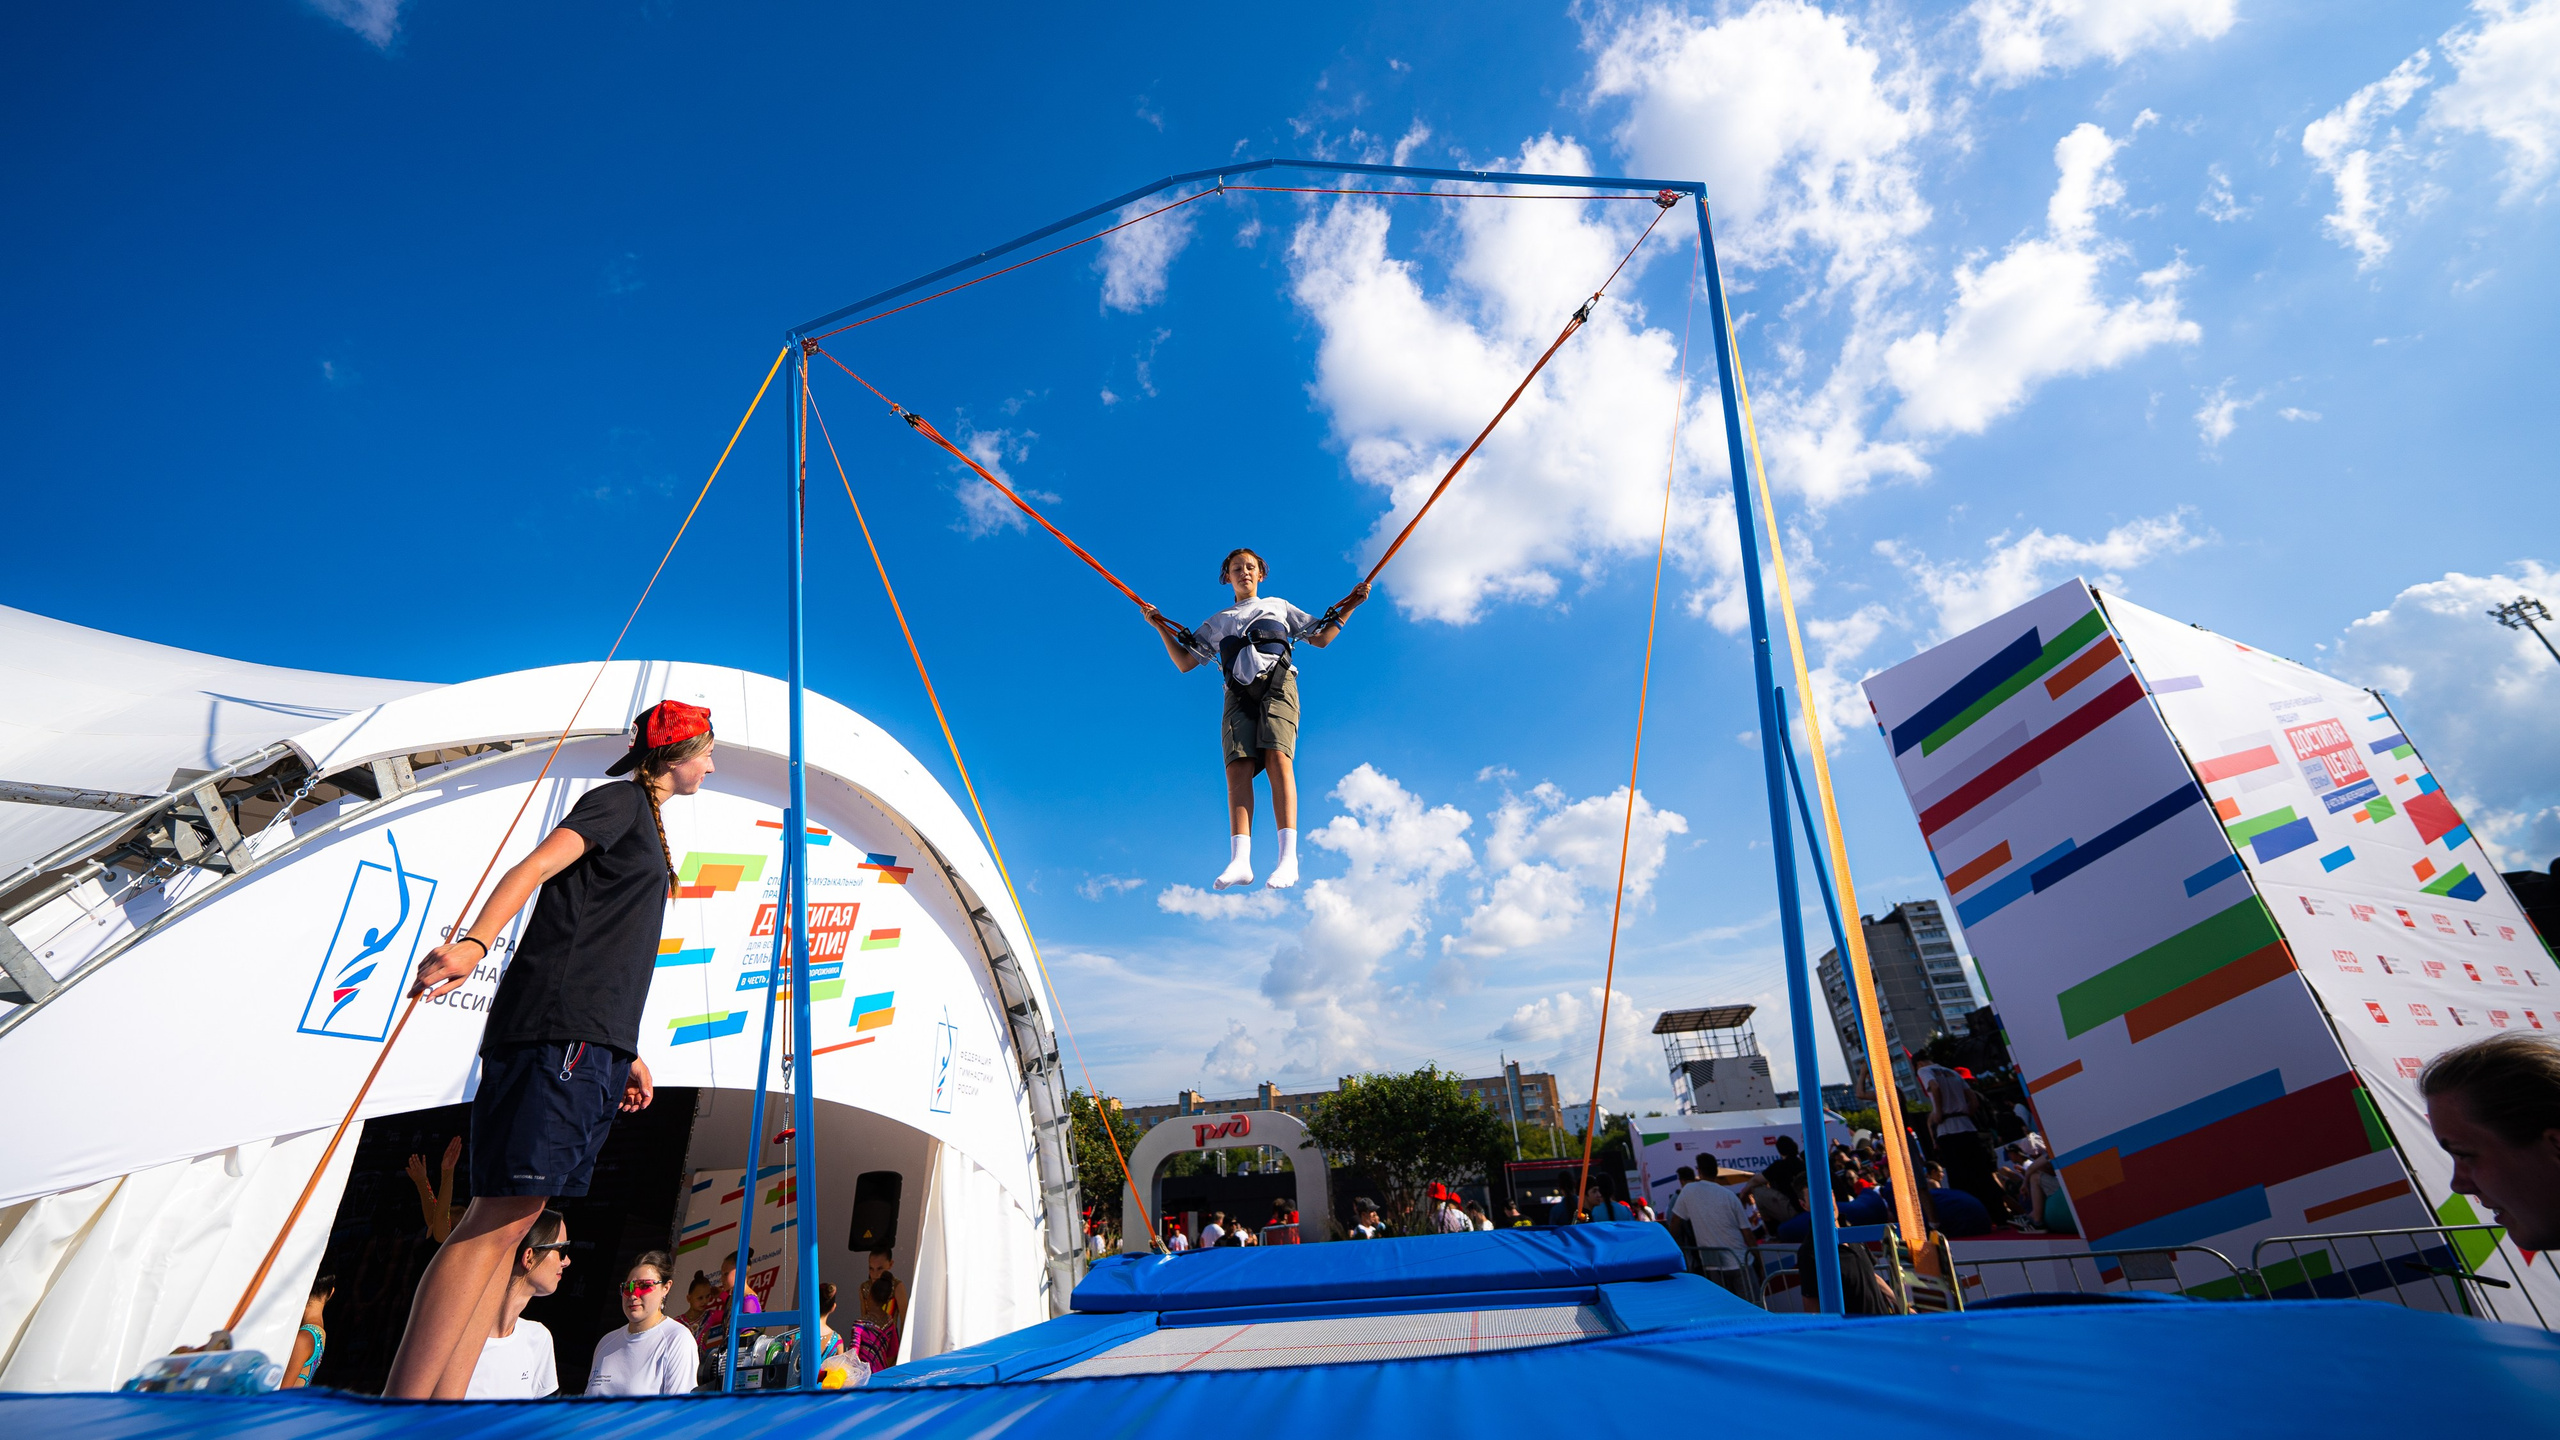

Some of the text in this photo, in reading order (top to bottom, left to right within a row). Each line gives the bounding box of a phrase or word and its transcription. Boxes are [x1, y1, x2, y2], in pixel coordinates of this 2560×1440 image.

[2289, 721, 2349, 760] ДОСТИГАЯ
[2321, 746, 2366, 783] ЦЕЛИ!
[740, 977, 747, 986] В
[747, 975, 767, 985] ЧЕСТЬ
